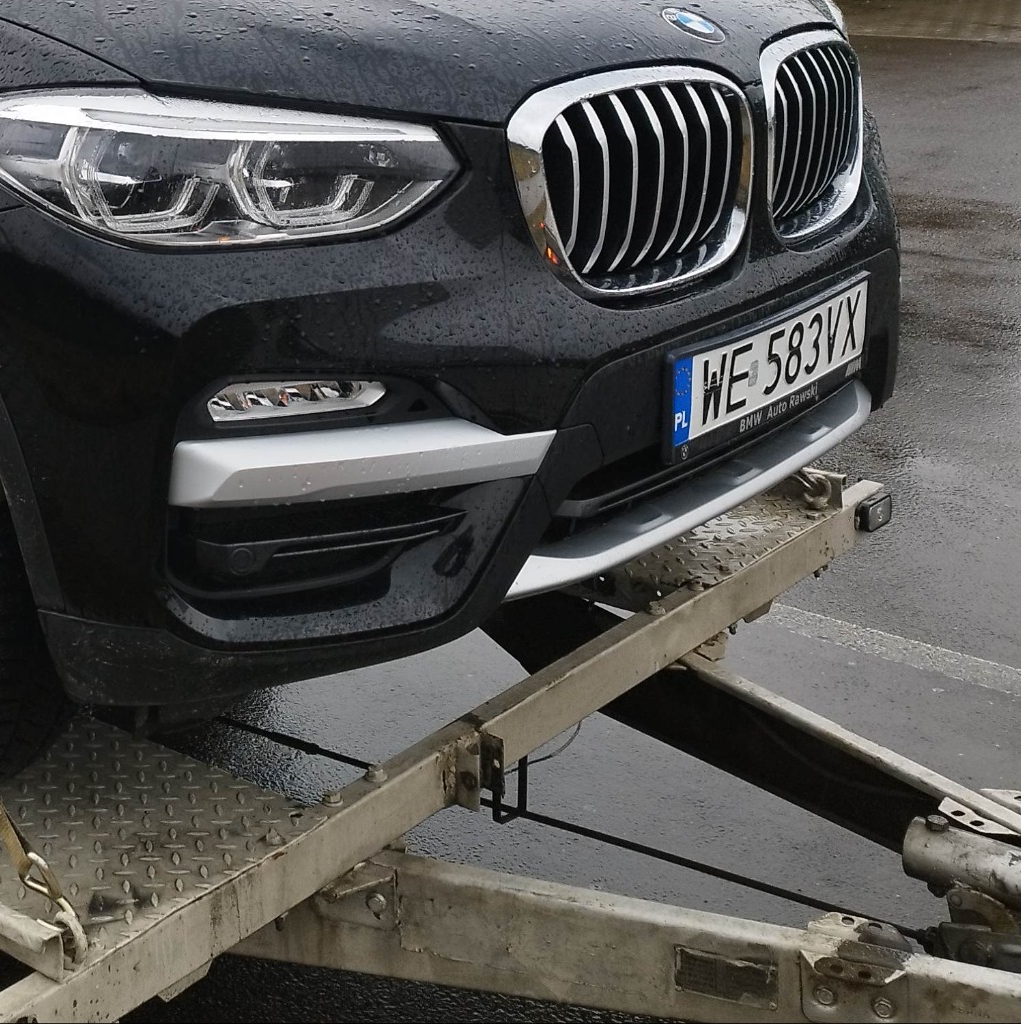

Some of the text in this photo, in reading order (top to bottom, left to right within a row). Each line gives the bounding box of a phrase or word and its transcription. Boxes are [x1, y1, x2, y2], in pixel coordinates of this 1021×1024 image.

[702, 290, 861, 426] WE 583VX
[674, 410, 688, 432] PL
[739, 381, 818, 433] BMW Auto Rawski
